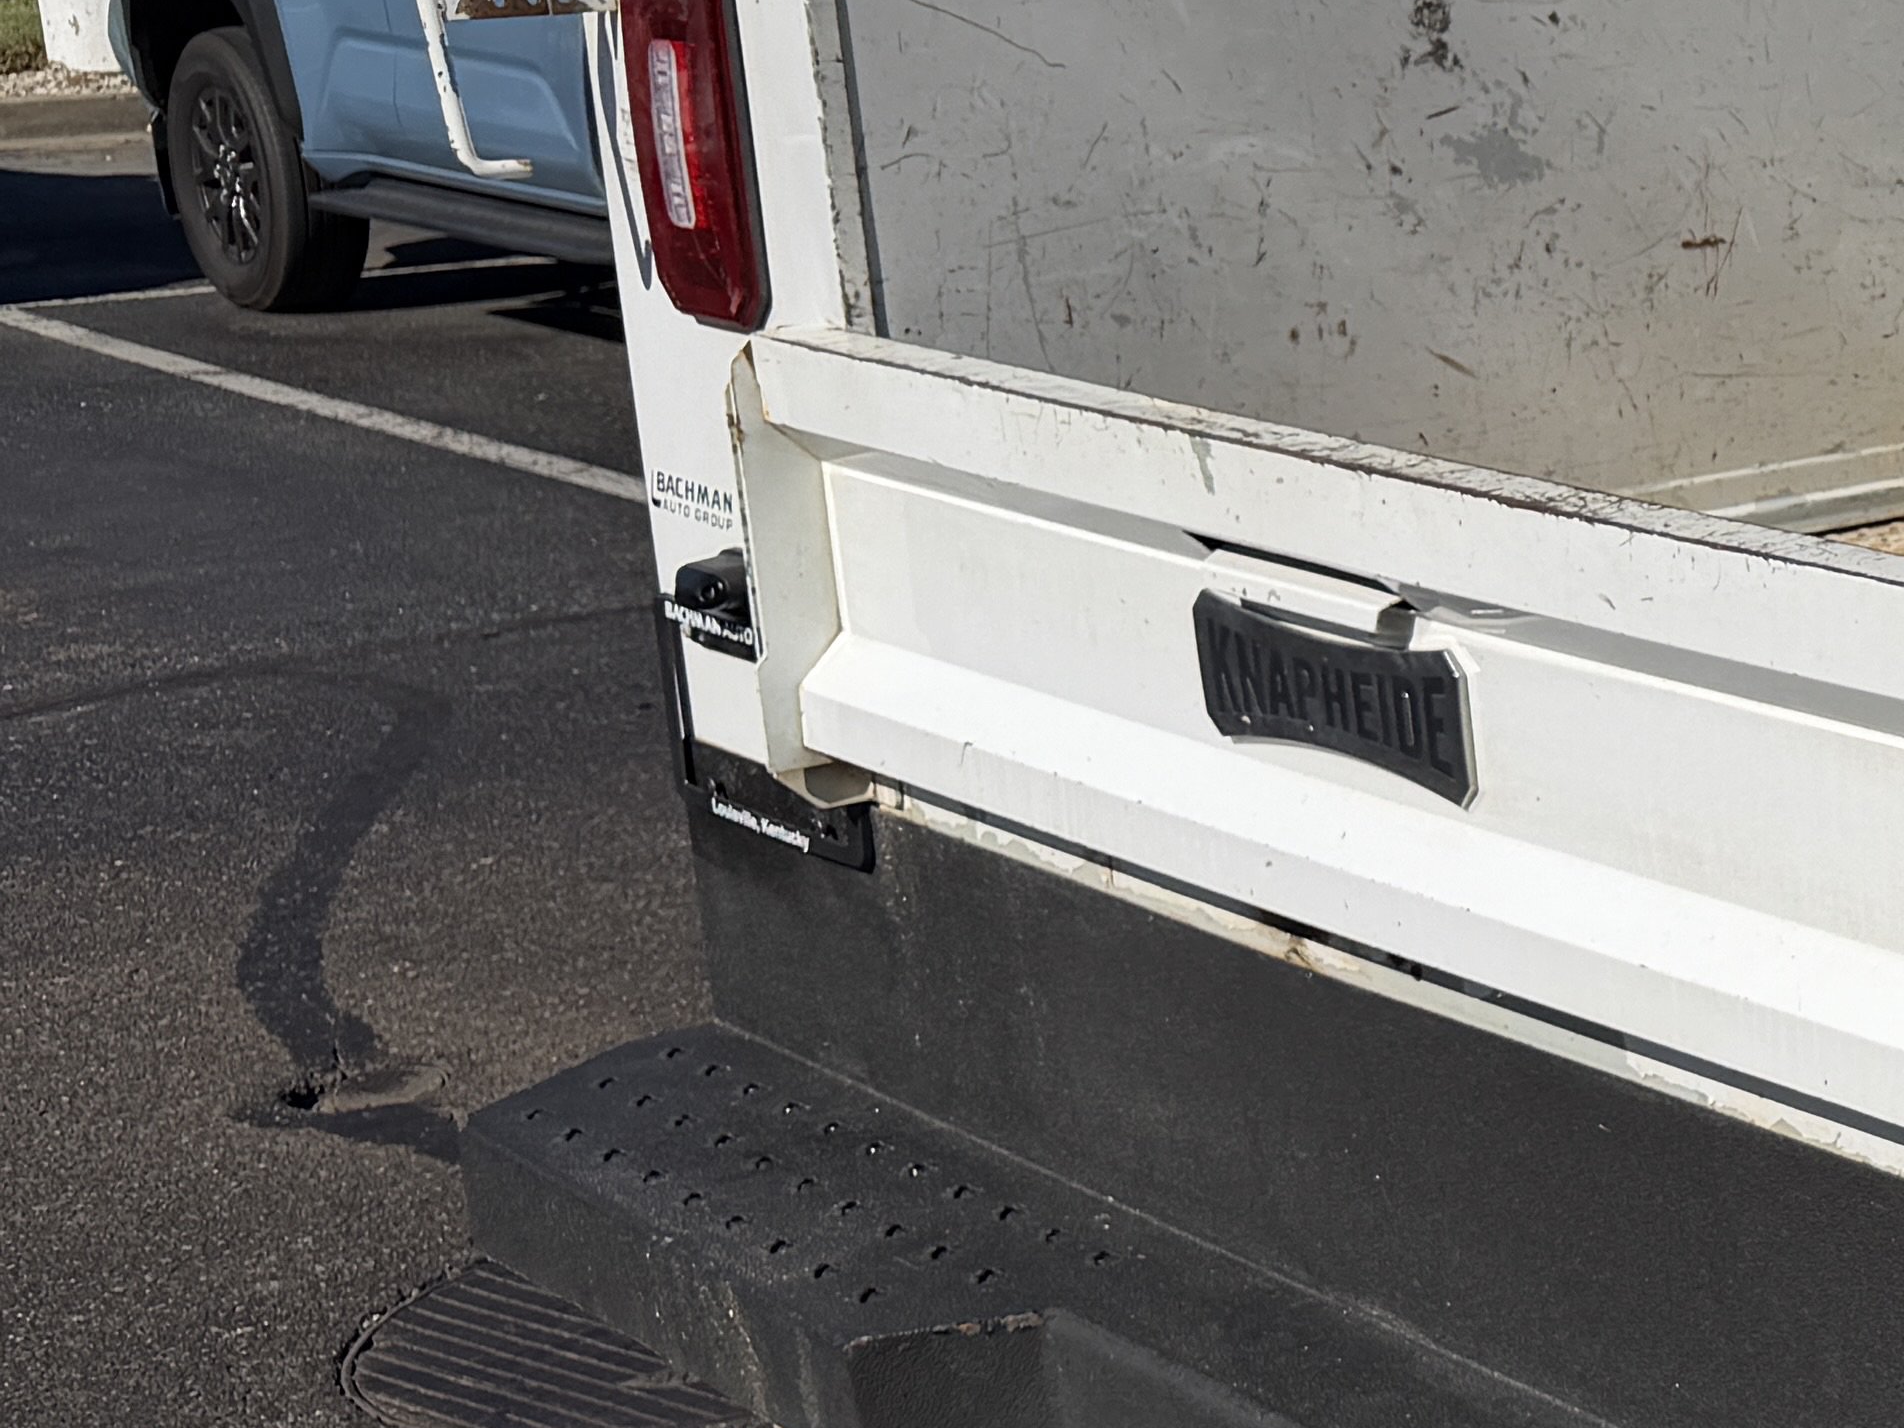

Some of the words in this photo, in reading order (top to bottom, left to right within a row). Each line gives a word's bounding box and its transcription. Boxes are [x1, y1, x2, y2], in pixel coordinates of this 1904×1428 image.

[656, 471, 733, 514] BACHMAN
[663, 498, 691, 518] AUTO
[694, 507, 733, 532] GROUP
[664, 600, 721, 637] BACHMAN
[1205, 617, 1456, 777] KNAPHEIDE
